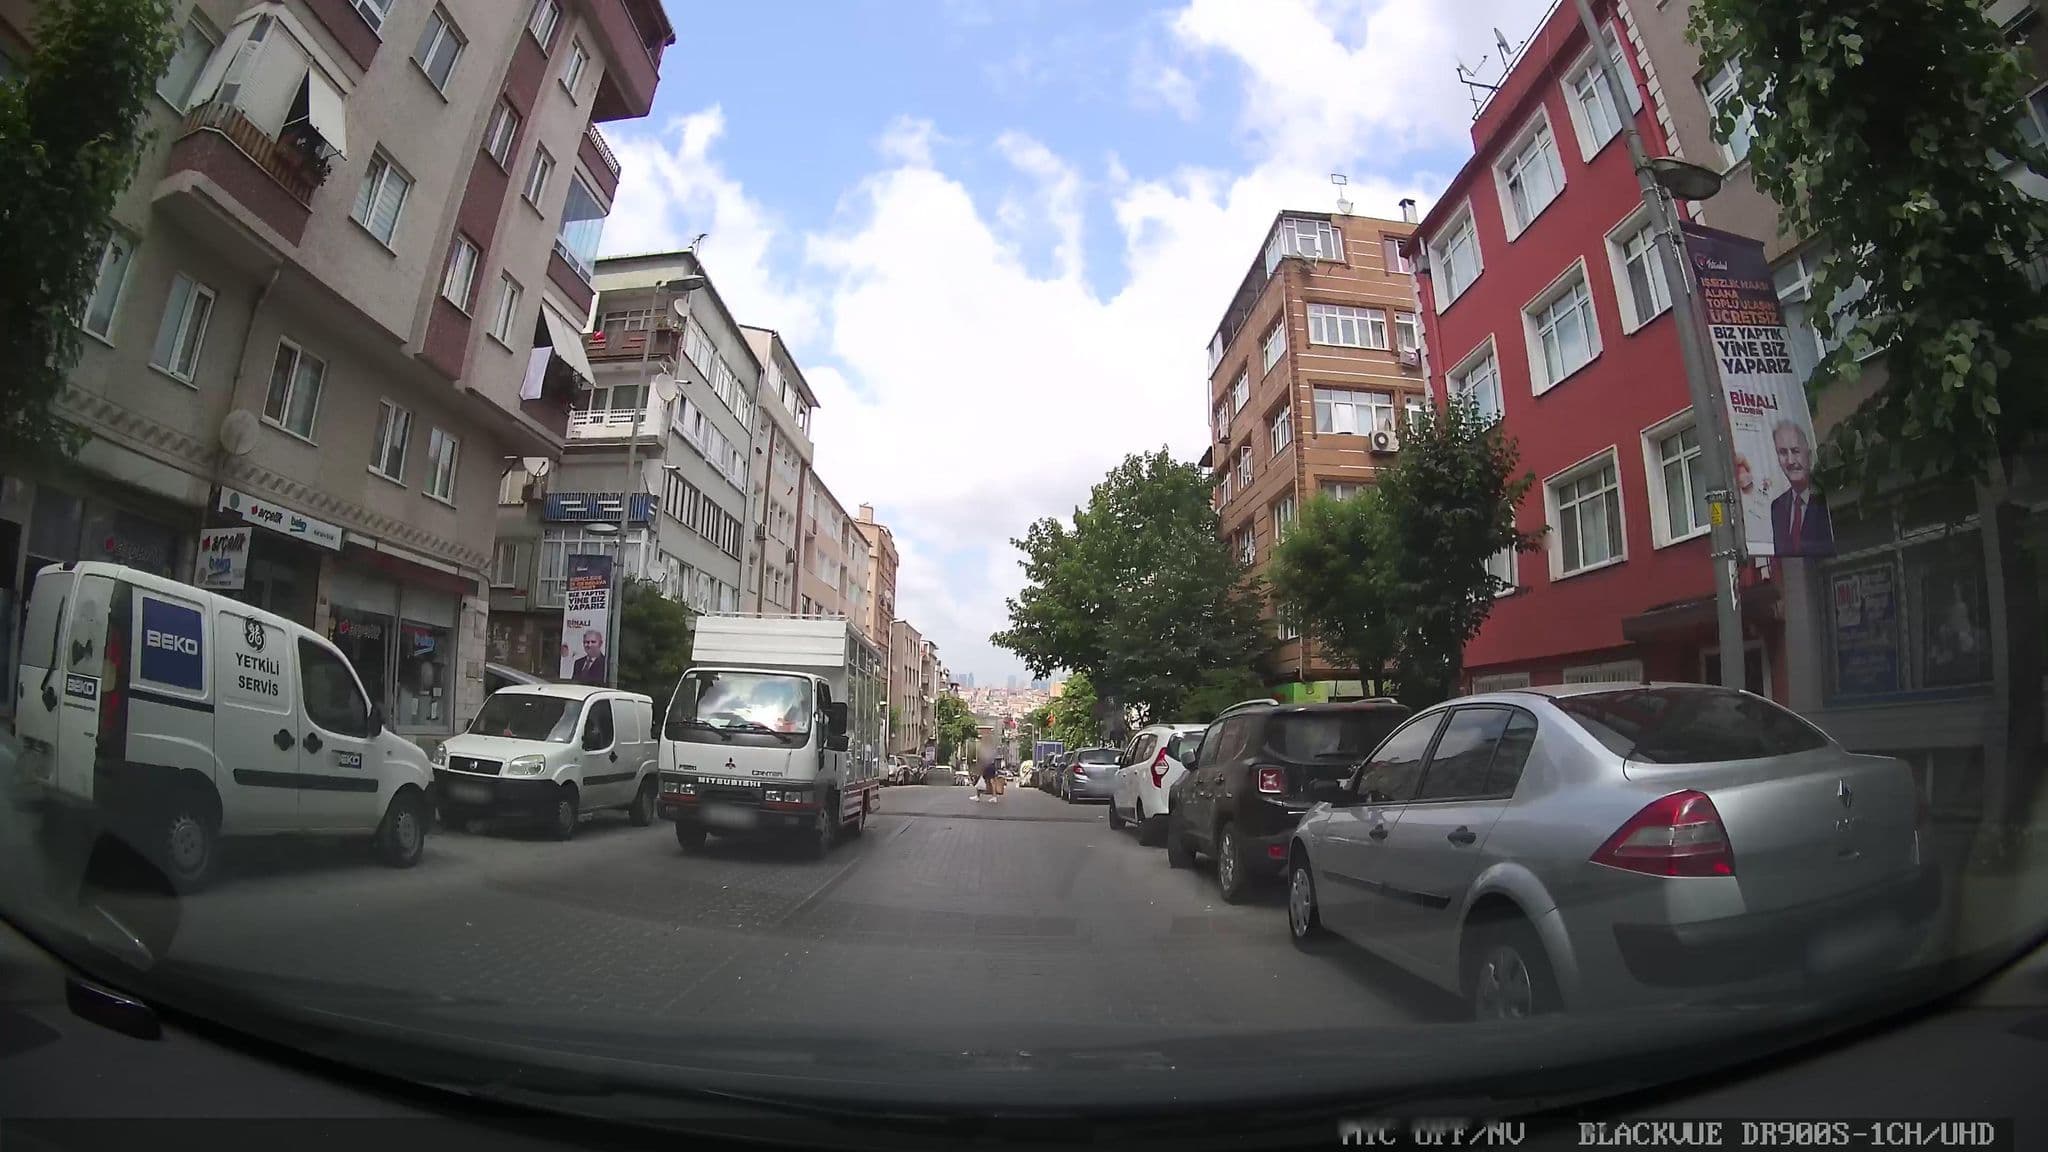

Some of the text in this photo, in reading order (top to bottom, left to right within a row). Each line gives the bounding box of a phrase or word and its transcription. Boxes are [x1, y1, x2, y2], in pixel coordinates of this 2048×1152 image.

[1706, 298, 1739, 310] TOPLU
[1713, 326, 1784, 341] BİZ YAPTIK
[1717, 341, 1789, 357] YİNE BİZ
[1721, 358, 1793, 374] YAPARIZ
[1729, 389, 1778, 410] BİNALİ
[258, 508, 283, 524] arçelik
[212, 533, 247, 557] arçelik
[568, 602, 606, 611] YAPARIZ
[146, 629, 198, 656] BEKO
[235, 652, 280, 676] YETKİLİ
[67, 678, 95, 696] BEKO
[237, 674, 279, 697] SERVİS
[698, 776, 761, 788] MITSUBISHI
